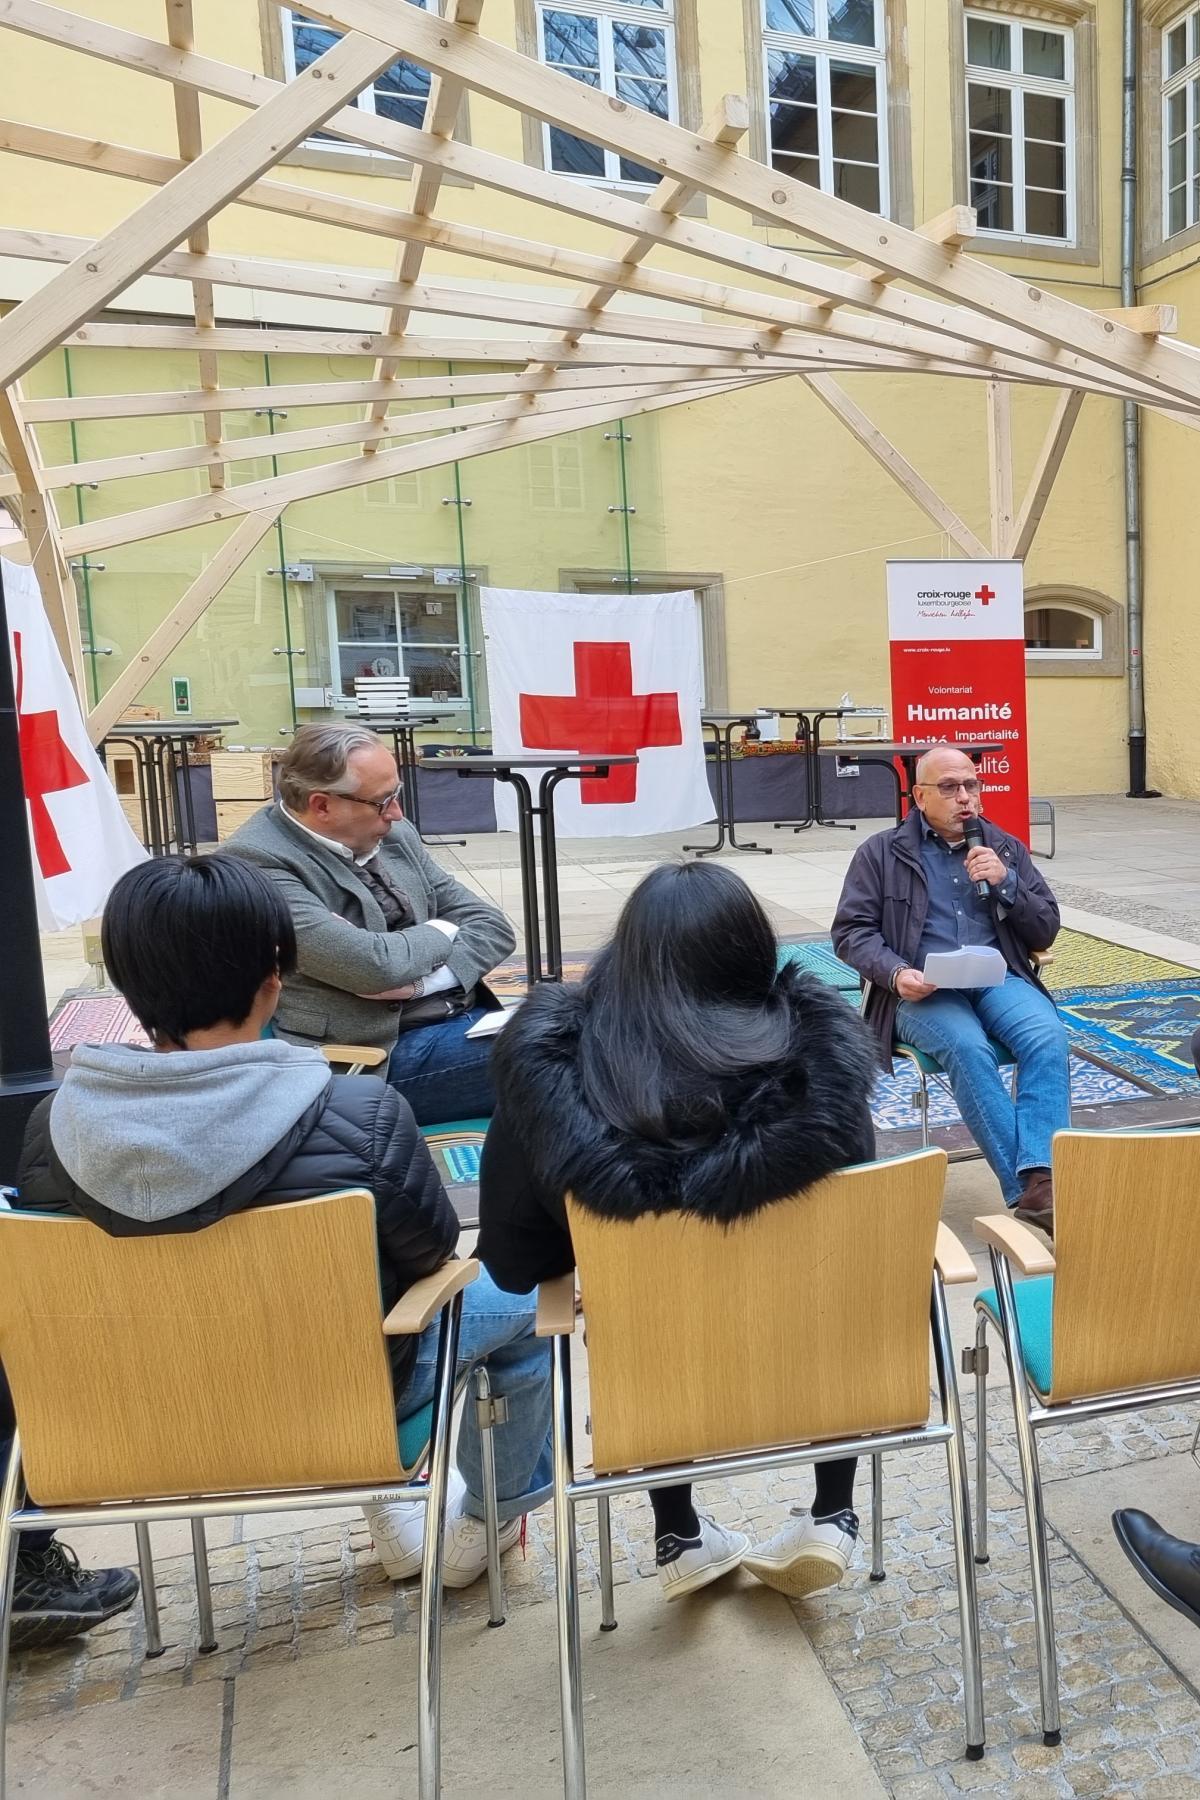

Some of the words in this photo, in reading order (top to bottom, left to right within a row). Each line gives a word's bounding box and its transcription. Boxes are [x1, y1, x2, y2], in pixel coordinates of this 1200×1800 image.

[917, 589, 971, 600] croix-rouge
[928, 686, 973, 695] Volontariat
[907, 702, 1012, 721] Humanité
[955, 729, 1019, 743] Impartialité
[372, 1493, 401, 1502] BRAUN
[457, 1533, 475, 1543] AIR
